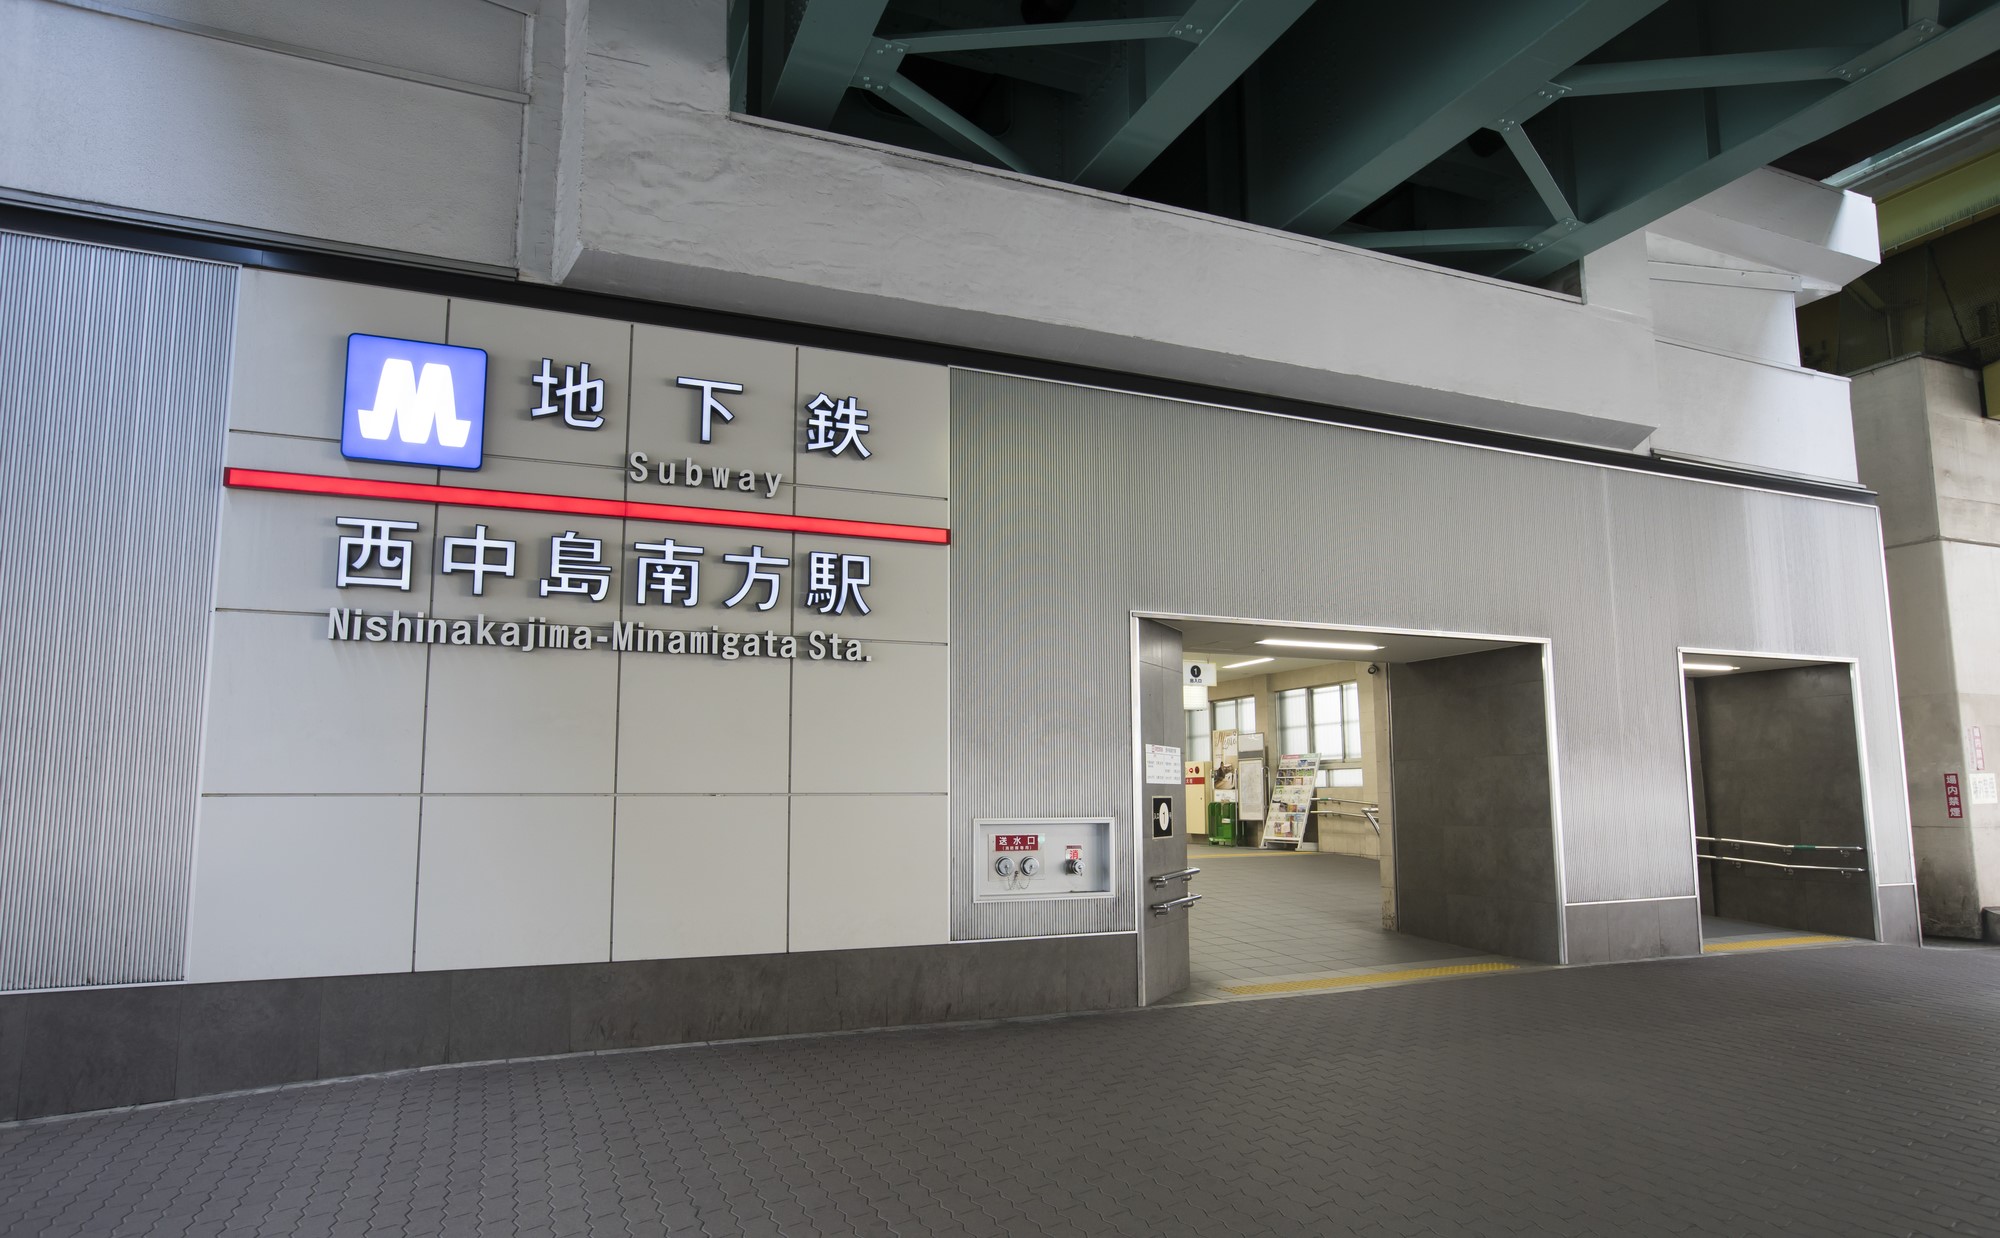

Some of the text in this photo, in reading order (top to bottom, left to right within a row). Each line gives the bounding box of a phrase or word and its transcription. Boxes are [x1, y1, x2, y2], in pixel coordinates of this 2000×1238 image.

[530, 357, 873, 460] 地下鉄
[629, 452, 784, 498] Subway
[336, 516, 872, 616] 西中島南方駅
[328, 608, 873, 662] Nishinakajima-Minamigata Sta.
[1946, 775, 1961, 817] 場内禁煙
[999, 836, 1035, 845] 送水口
